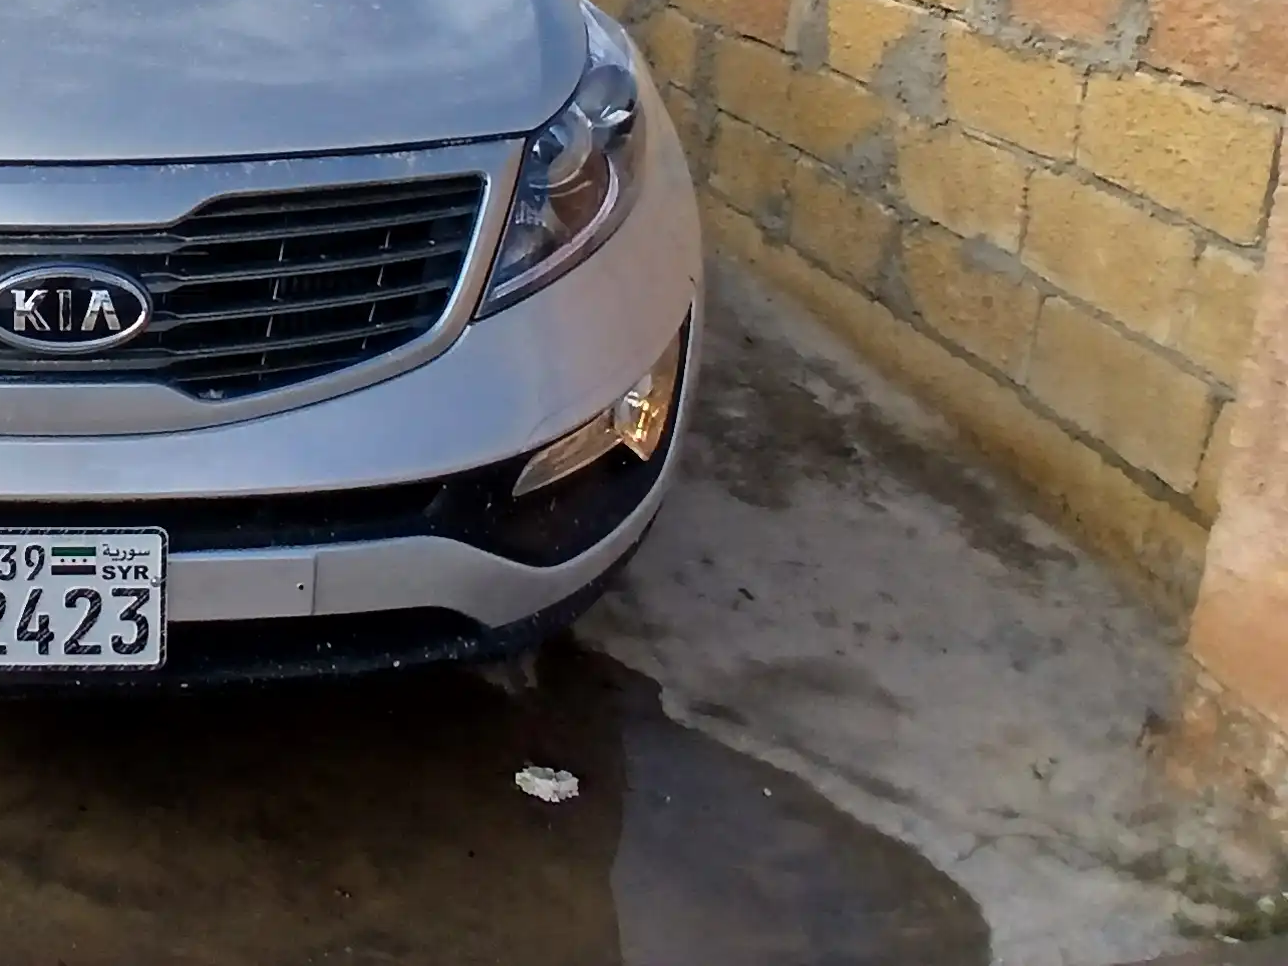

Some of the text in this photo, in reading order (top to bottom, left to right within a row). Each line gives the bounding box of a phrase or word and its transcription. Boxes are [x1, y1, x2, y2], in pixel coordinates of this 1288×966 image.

[10, 289, 121, 332] KIA
[101, 543, 151, 563] سورية
[101, 565, 150, 581] SYR
